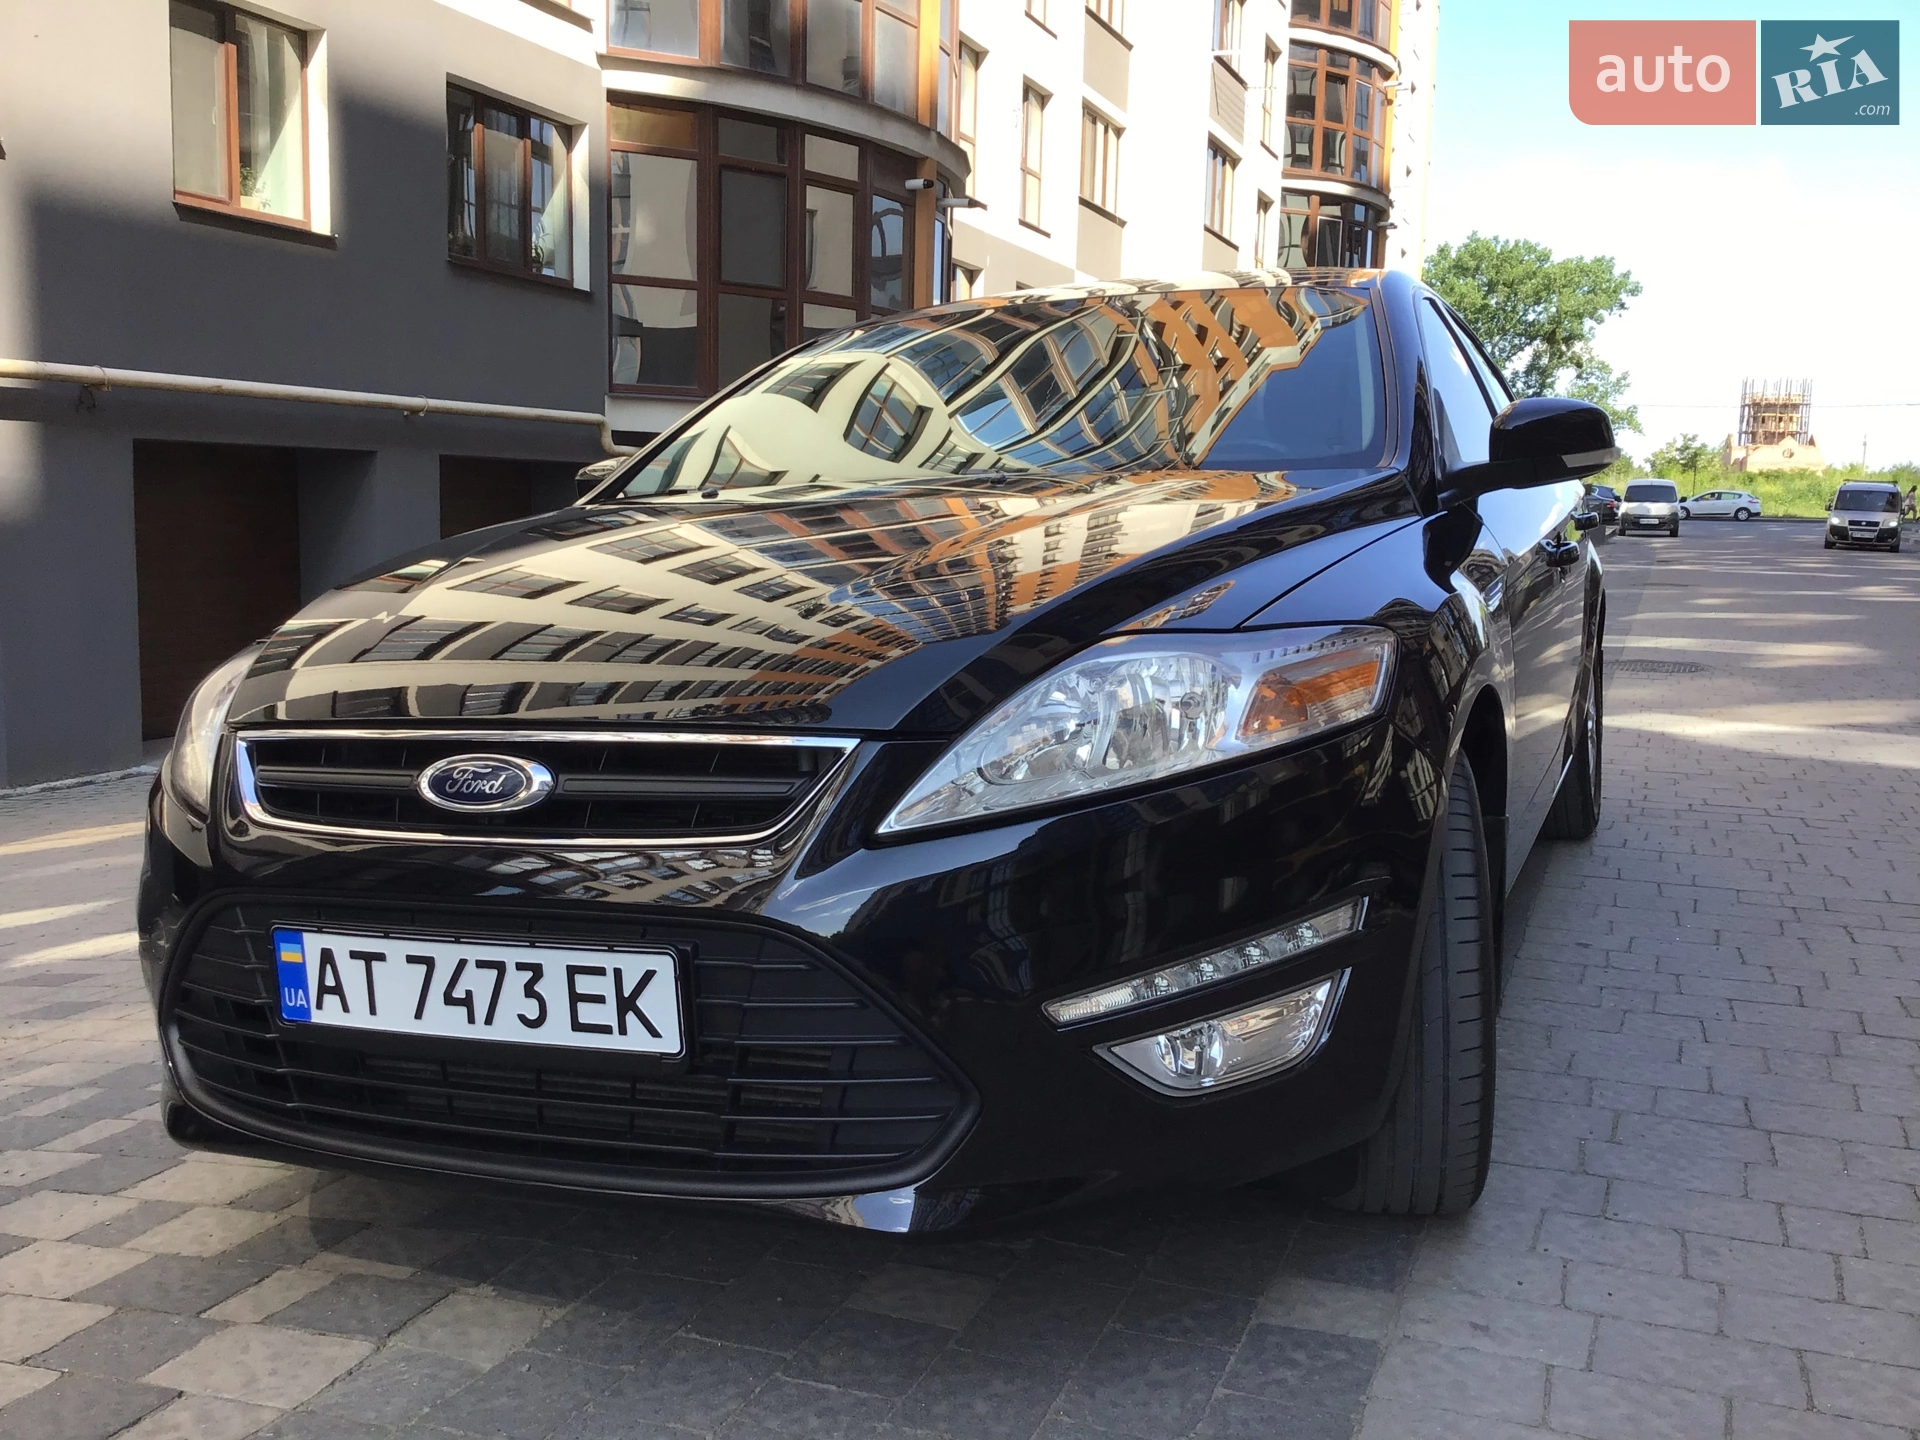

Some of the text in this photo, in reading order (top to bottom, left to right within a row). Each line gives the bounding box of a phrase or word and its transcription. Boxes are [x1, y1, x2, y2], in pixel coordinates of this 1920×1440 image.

[445, 766, 507, 795] Ford
[284, 986, 308, 1009] UA
[315, 947, 663, 1039] AT 7473 EK
